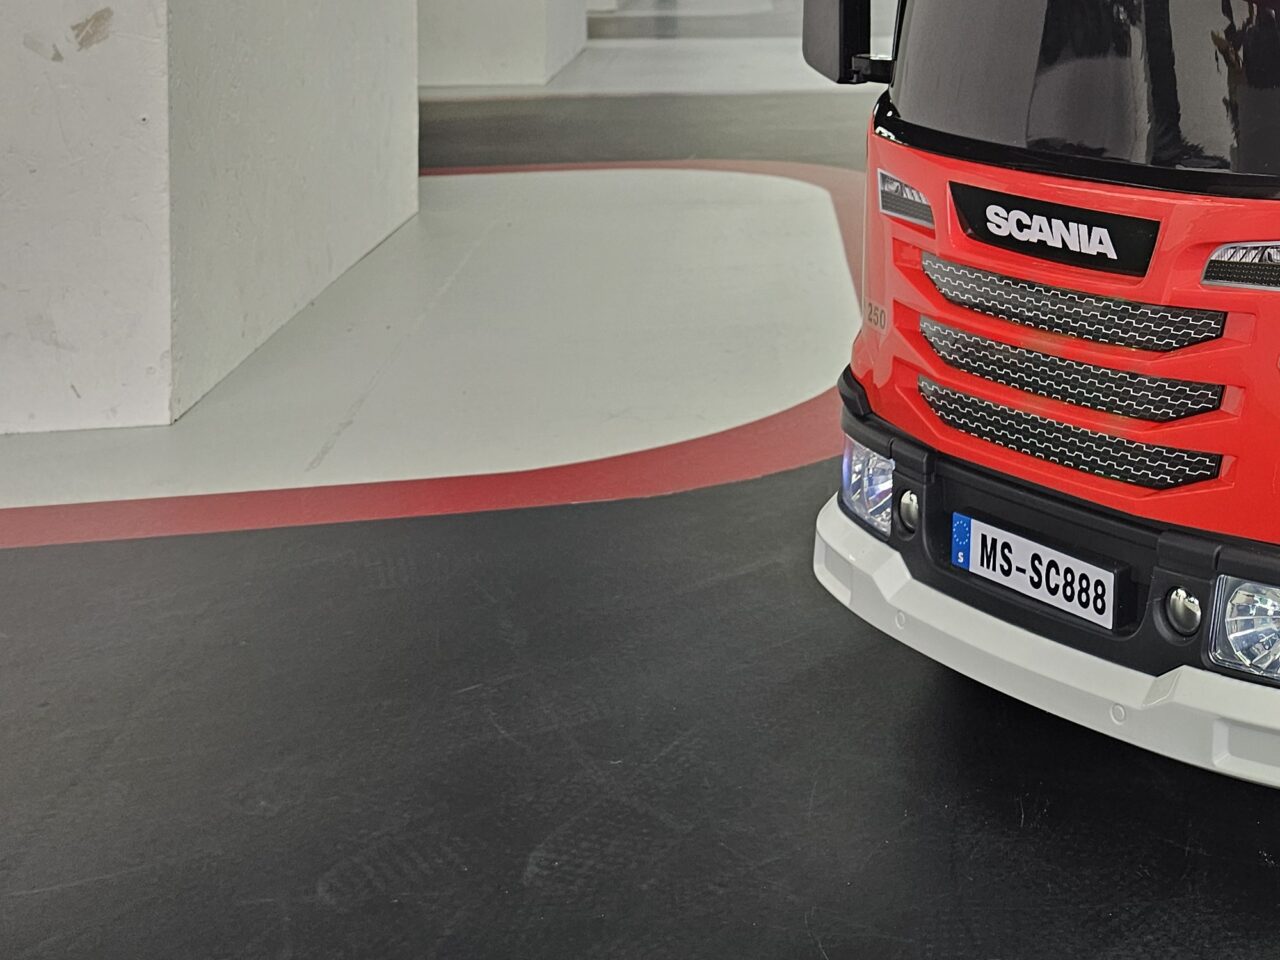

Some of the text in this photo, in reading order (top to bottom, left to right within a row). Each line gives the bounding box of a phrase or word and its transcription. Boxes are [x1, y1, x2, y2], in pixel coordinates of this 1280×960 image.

[985, 204, 1118, 260] SCANIA
[867, 302, 886, 330] 250
[957, 551, 965, 563] S
[979, 533, 1106, 616] MS-SC888
